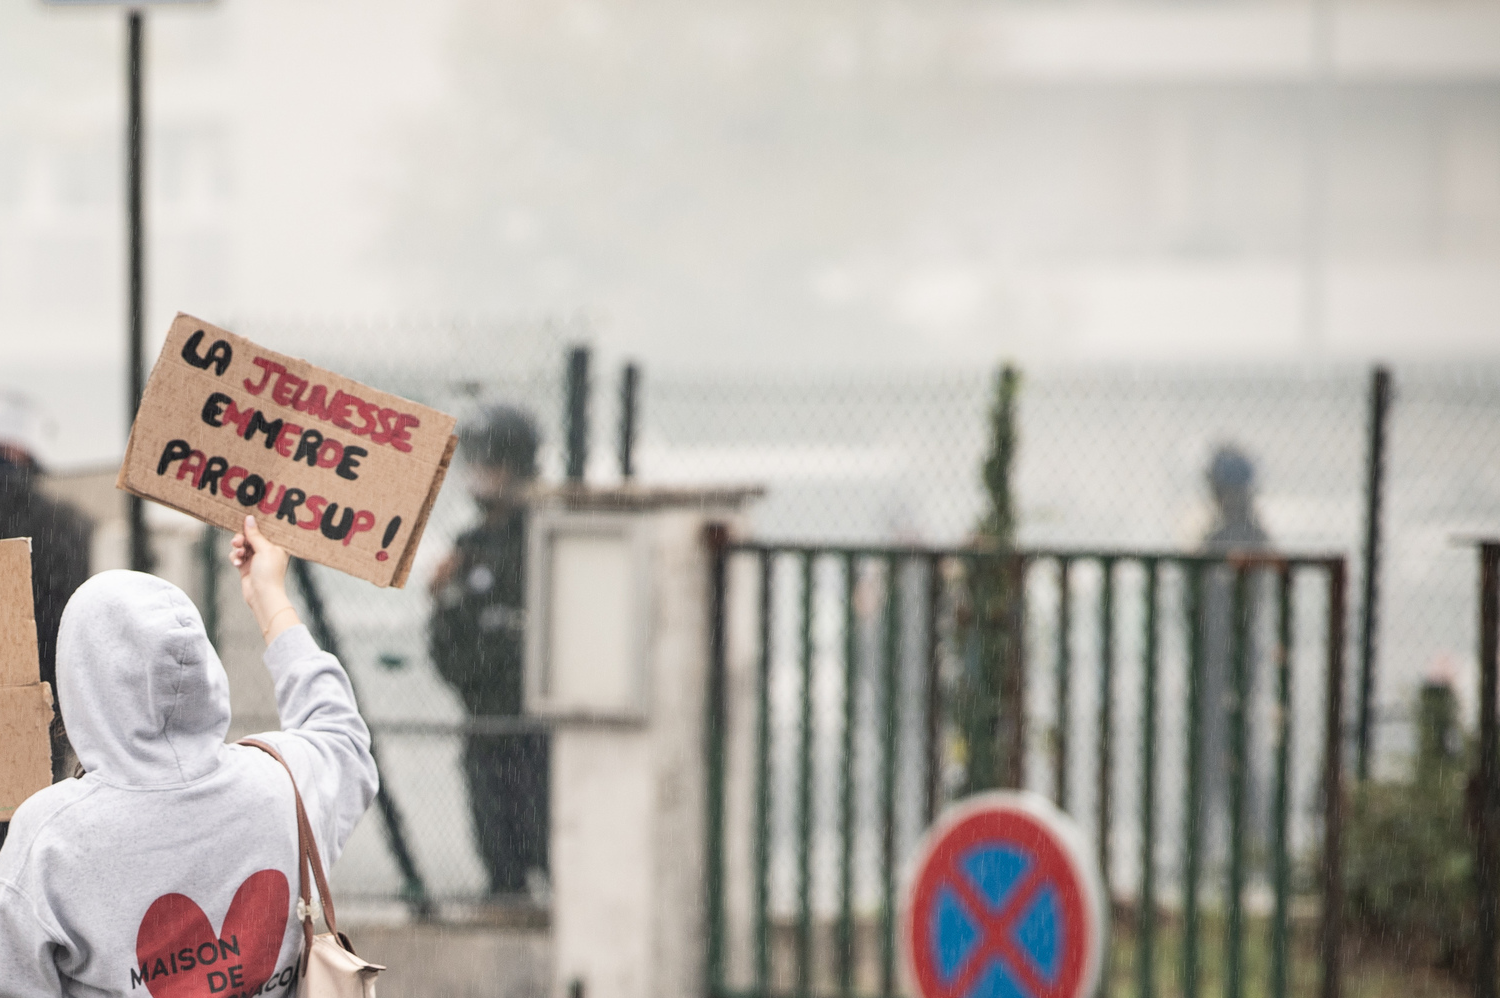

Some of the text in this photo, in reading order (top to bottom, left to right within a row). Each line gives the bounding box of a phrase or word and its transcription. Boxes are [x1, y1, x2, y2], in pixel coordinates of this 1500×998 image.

[182, 330, 419, 453] LA JEUNESSE
[202, 392, 368, 480] EMMERDE
[157, 439, 375, 546] PARCOURSUP
[130, 935, 241, 990] MAISON
[207, 965, 244, 994] DE
